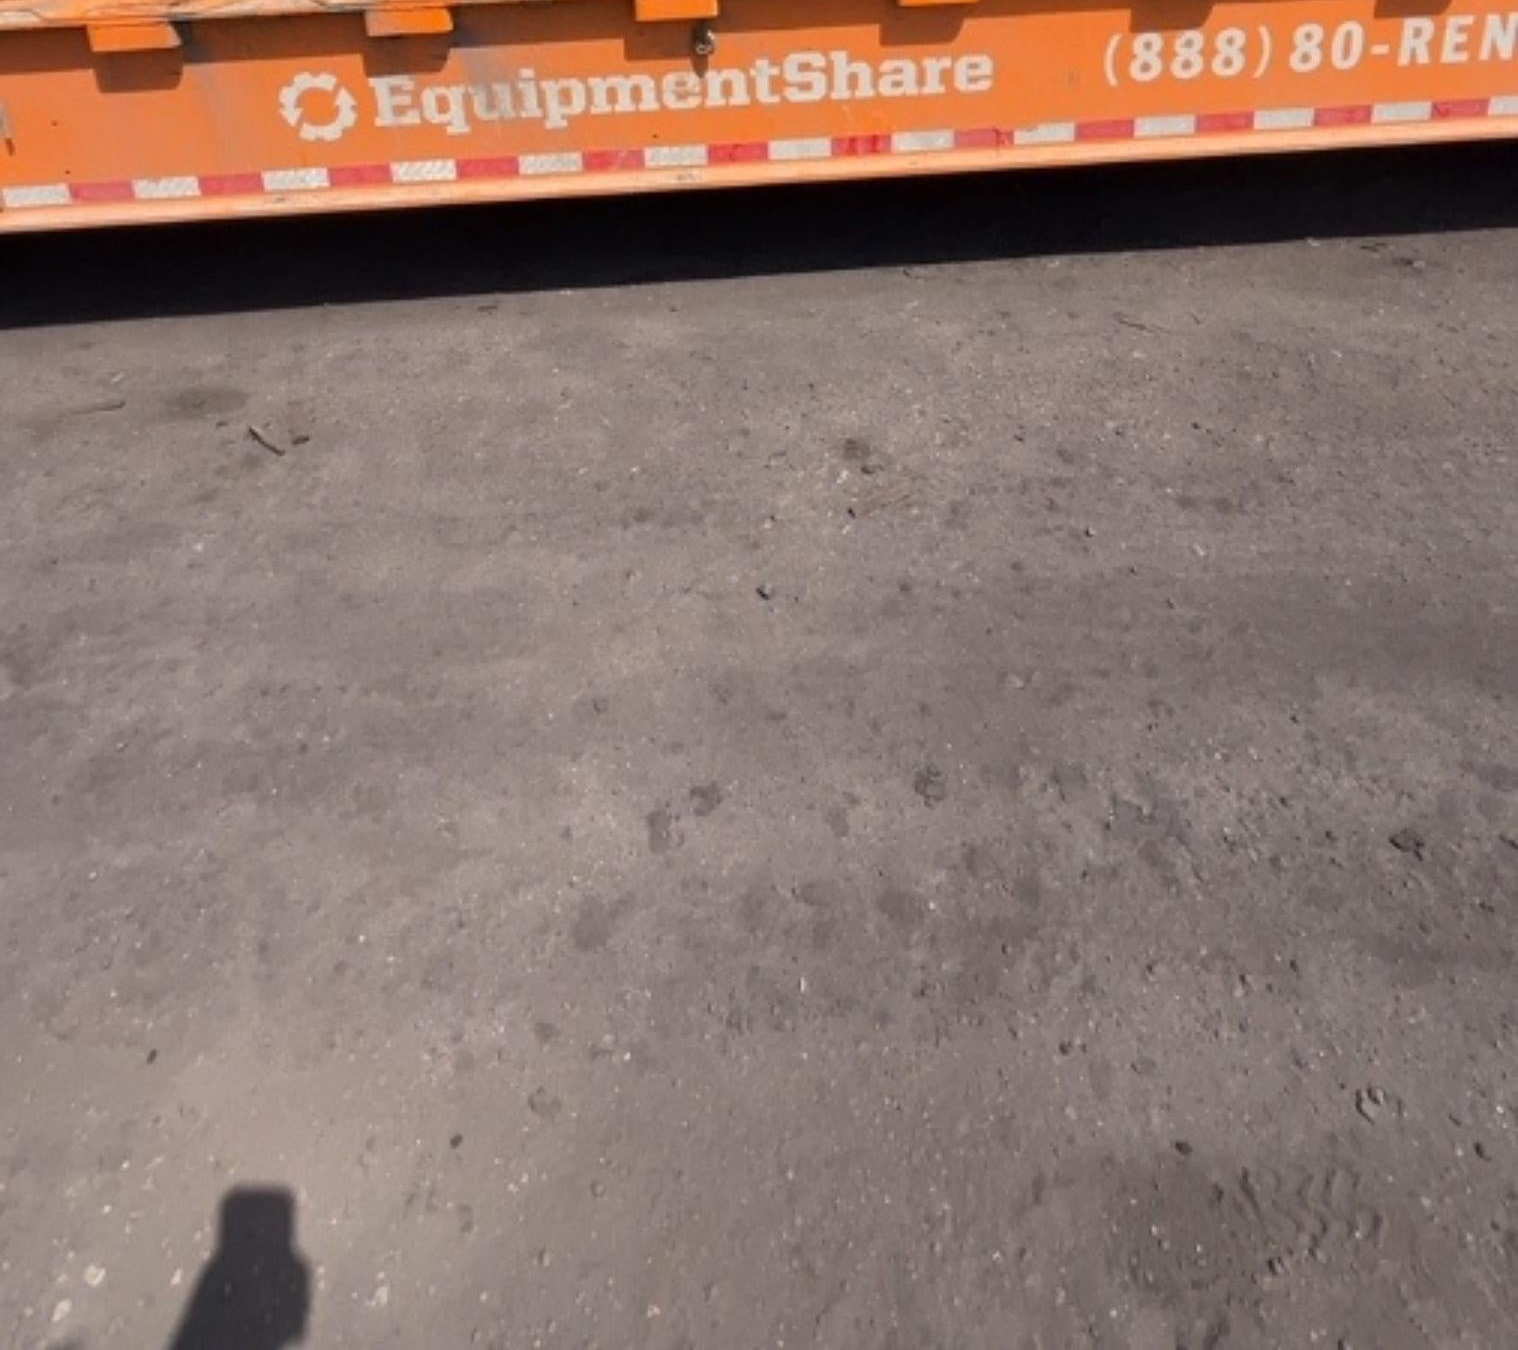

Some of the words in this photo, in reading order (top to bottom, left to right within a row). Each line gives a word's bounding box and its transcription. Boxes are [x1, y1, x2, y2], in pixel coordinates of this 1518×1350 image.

[1104, 26, 1272, 86] (888)
[1289, 11, 1518, 73] 80-REN
[368, 50, 995, 133] EquipmentShare
